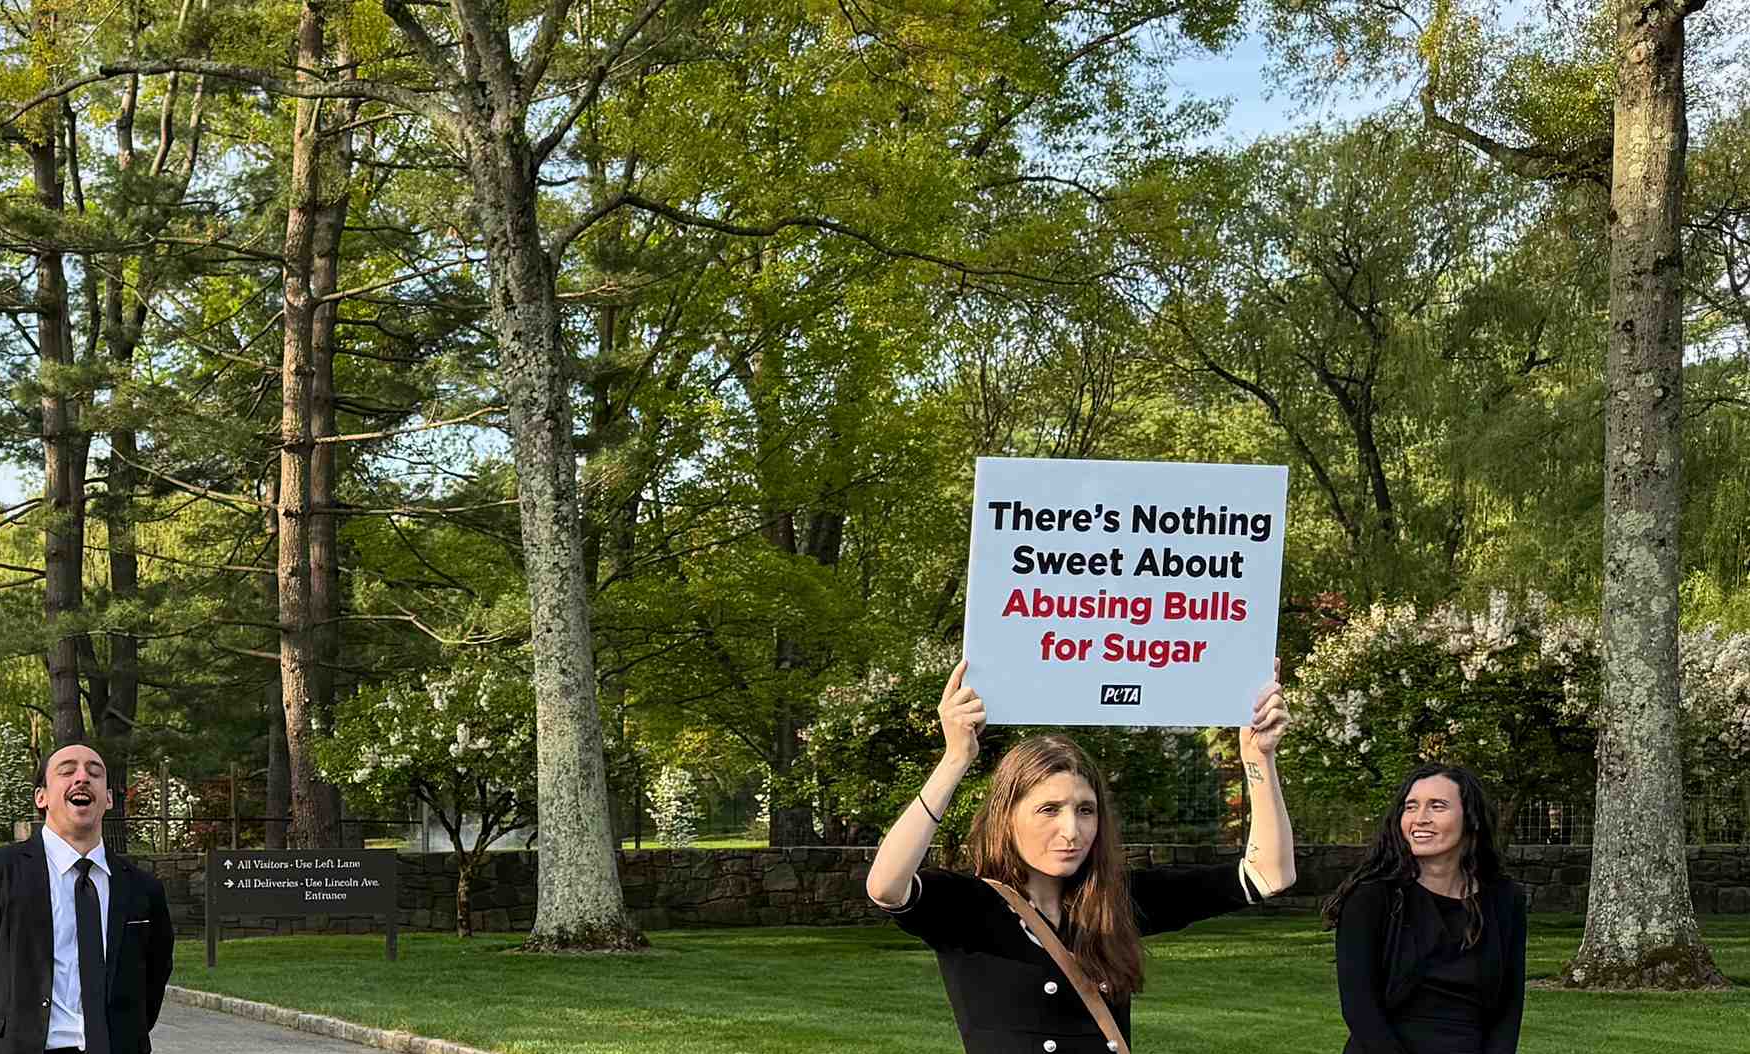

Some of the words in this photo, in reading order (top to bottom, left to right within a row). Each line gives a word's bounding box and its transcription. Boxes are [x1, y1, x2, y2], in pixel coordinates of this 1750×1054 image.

[988, 500, 1120, 533] There’s
[1131, 504, 1272, 543] Nothing
[1011, 545, 1124, 577] Sweet
[1133, 547, 1244, 579] About
[1001, 588, 1152, 625] Abusing
[1163, 591, 1247, 622] Bulls
[1040, 631, 1093, 661] for
[1102, 633, 1207, 669] Sugar
[237, 859, 251, 870] All
[253, 859, 289, 869] Visitors
[295, 859, 313, 869] Use
[314, 858, 335, 869] Left
[337, 858, 361, 869] Lane
[237, 878, 251, 889] All
[253, 878, 299, 889] Deliveries
[305, 878, 323, 888] Use
[324, 877, 359, 888] Lincoln
[305, 890, 347, 901] Entrance
